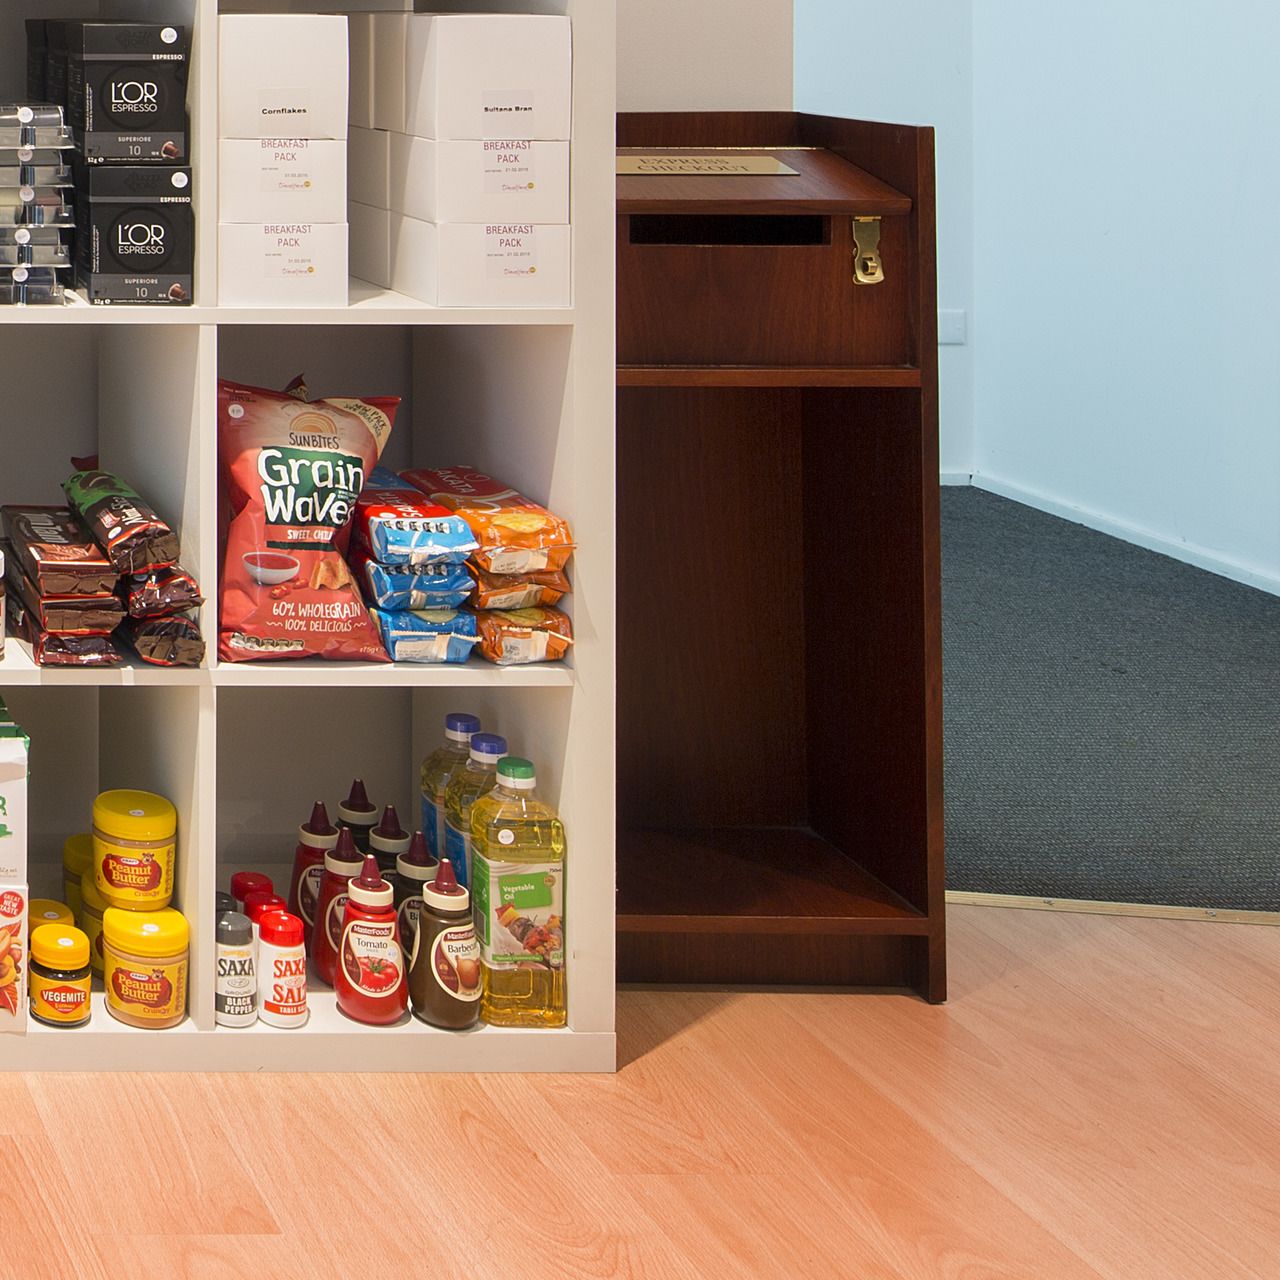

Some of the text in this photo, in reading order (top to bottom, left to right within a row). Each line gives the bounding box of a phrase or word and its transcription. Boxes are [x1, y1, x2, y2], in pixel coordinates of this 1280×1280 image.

[112, 81, 157, 103] L'OR
[112, 104, 157, 112] ESPRESSO
[119, 224, 164, 245] L'OR
[289, 432, 339, 448] SUNBITES
[257, 448, 364, 493] Grain
[108, 859, 151, 876] Peanut
[112, 871, 149, 884] Butter
[503, 884, 535, 893] Vegetable
[353, 925, 391, 936] MasterFoods
[356, 939, 388, 950] Tomato
[218, 958, 254, 977] SAXA
[42, 991, 85, 1002] VEGEMITE
[227, 997, 251, 1006] BLACK
